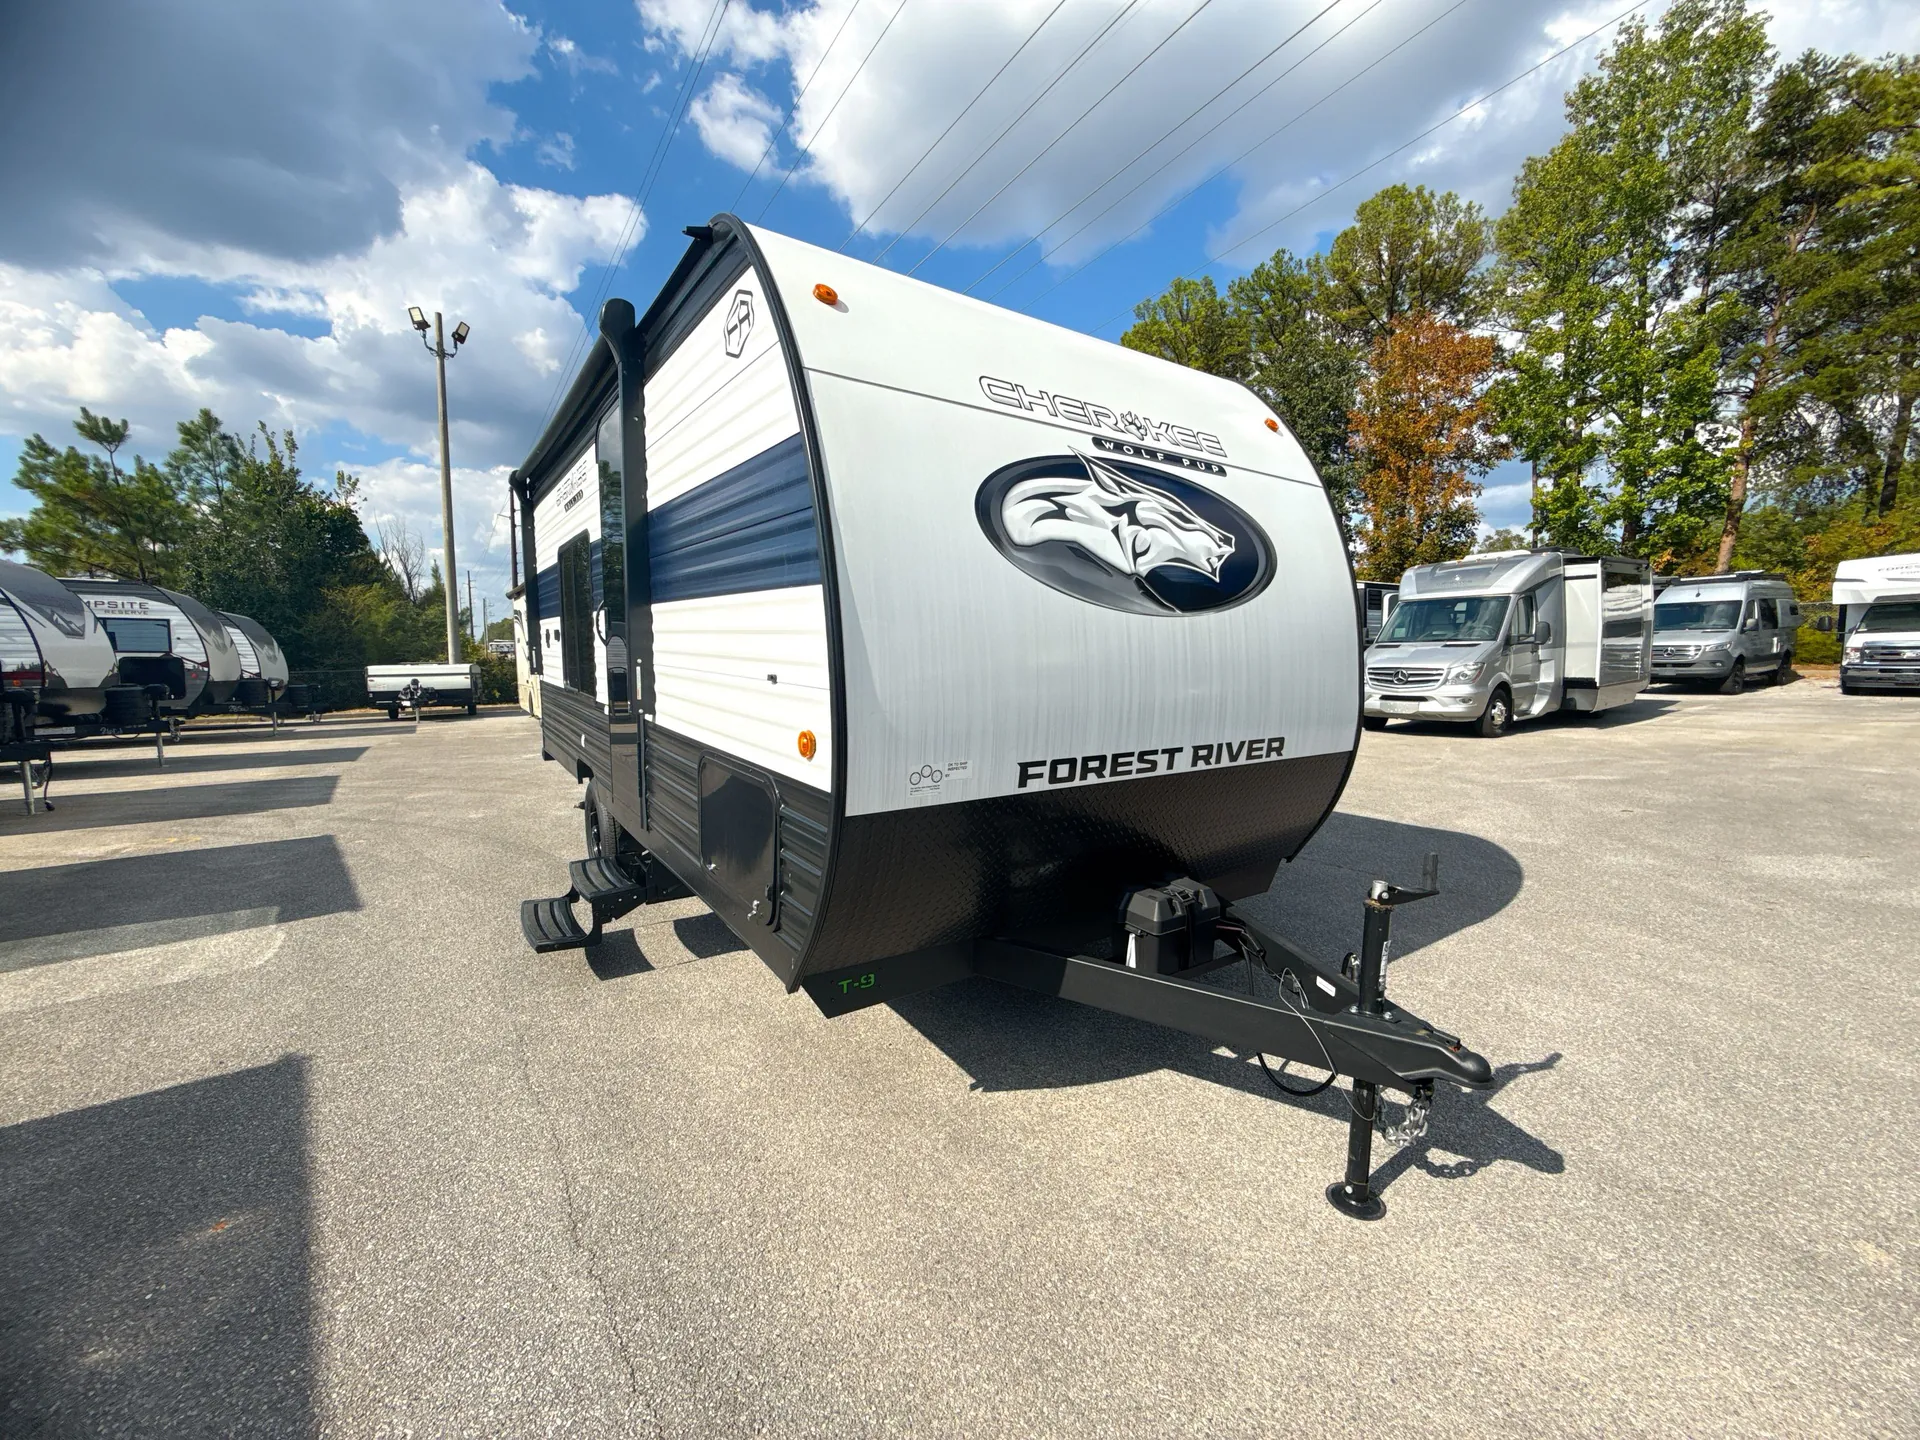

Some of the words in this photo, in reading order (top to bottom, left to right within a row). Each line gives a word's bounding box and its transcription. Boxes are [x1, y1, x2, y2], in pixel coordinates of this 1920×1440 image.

[1101, 440, 1165, 462] WOLF
[1183, 458, 1220, 473] PUP
[1017, 746, 1184, 789] FOREST
[1190, 736, 1285, 768] RIVER
[837, 973, 876, 995] T-9
